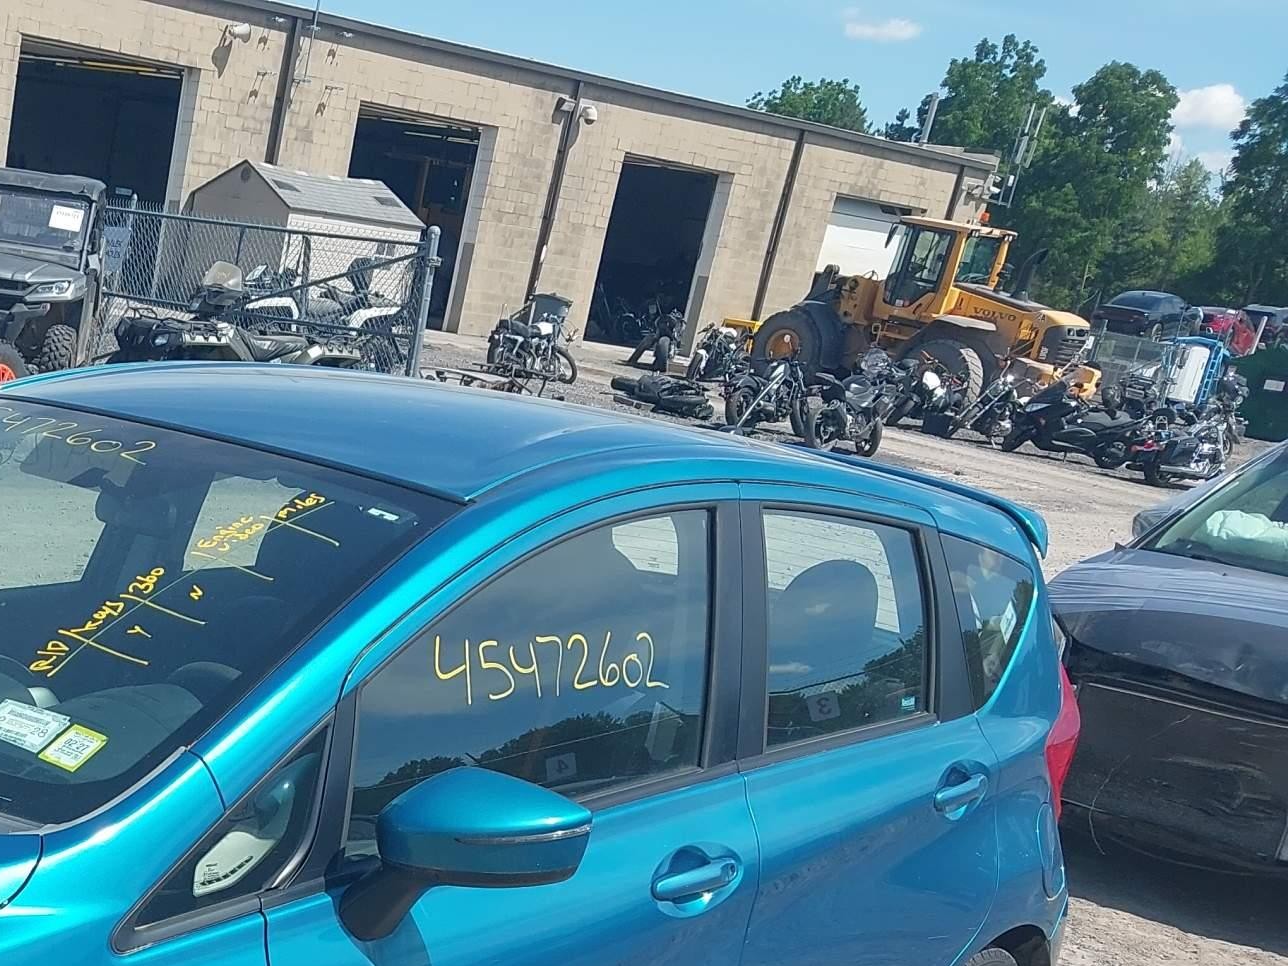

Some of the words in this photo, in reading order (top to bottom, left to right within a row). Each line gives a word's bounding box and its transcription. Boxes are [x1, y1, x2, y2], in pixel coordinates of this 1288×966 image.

[973, 306, 1017, 321] VOLVO
[128, 566, 165, 594] 360
[127, 625, 152, 638] Y
[189, 584, 204, 600] N
[434, 631, 670, 705] 45472602
